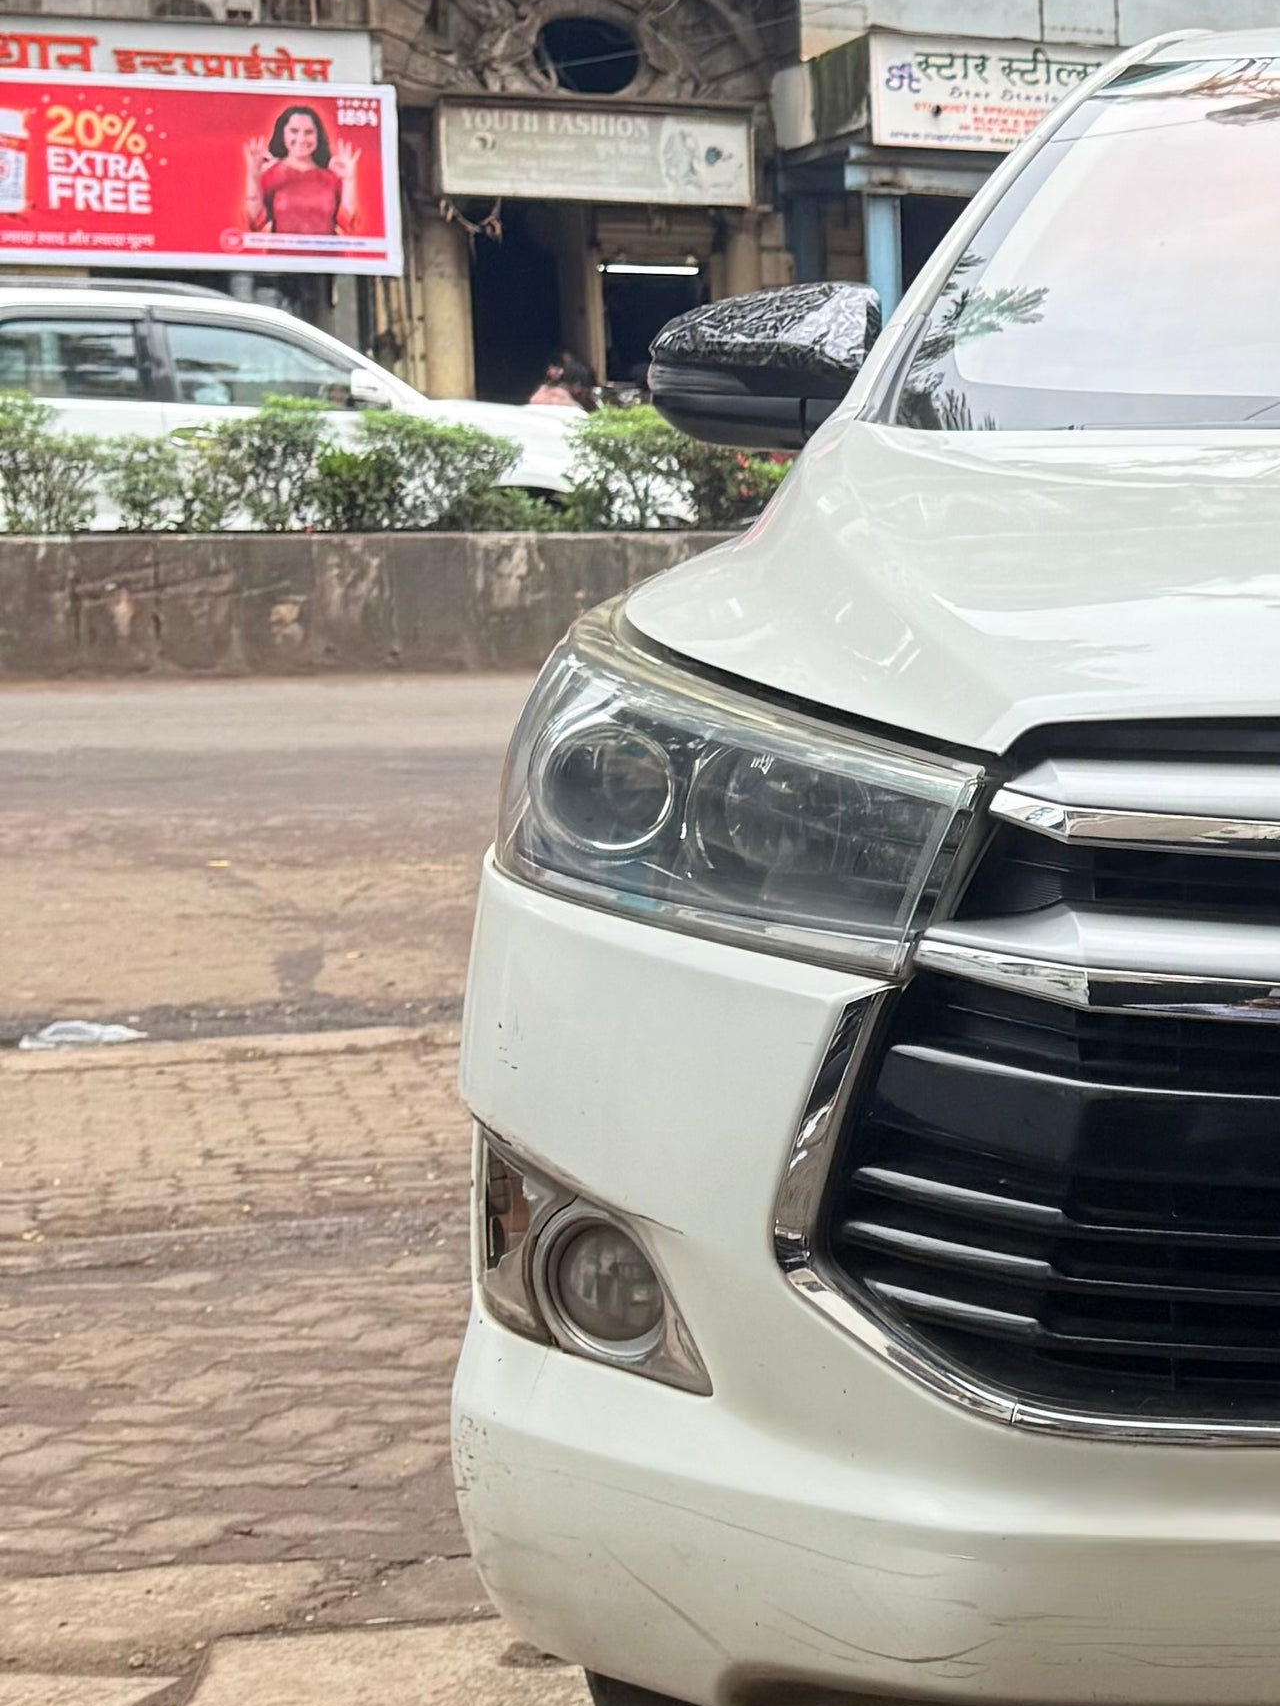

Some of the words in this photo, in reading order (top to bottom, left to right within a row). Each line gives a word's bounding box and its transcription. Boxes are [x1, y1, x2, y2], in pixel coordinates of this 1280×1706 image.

[46, 105, 148, 155] 20%
[461, 108, 539, 134] YOUTH
[548, 113, 649, 139] FASHION
[46, 145, 150, 181] EXTRA
[48, 174, 152, 215] FREE
